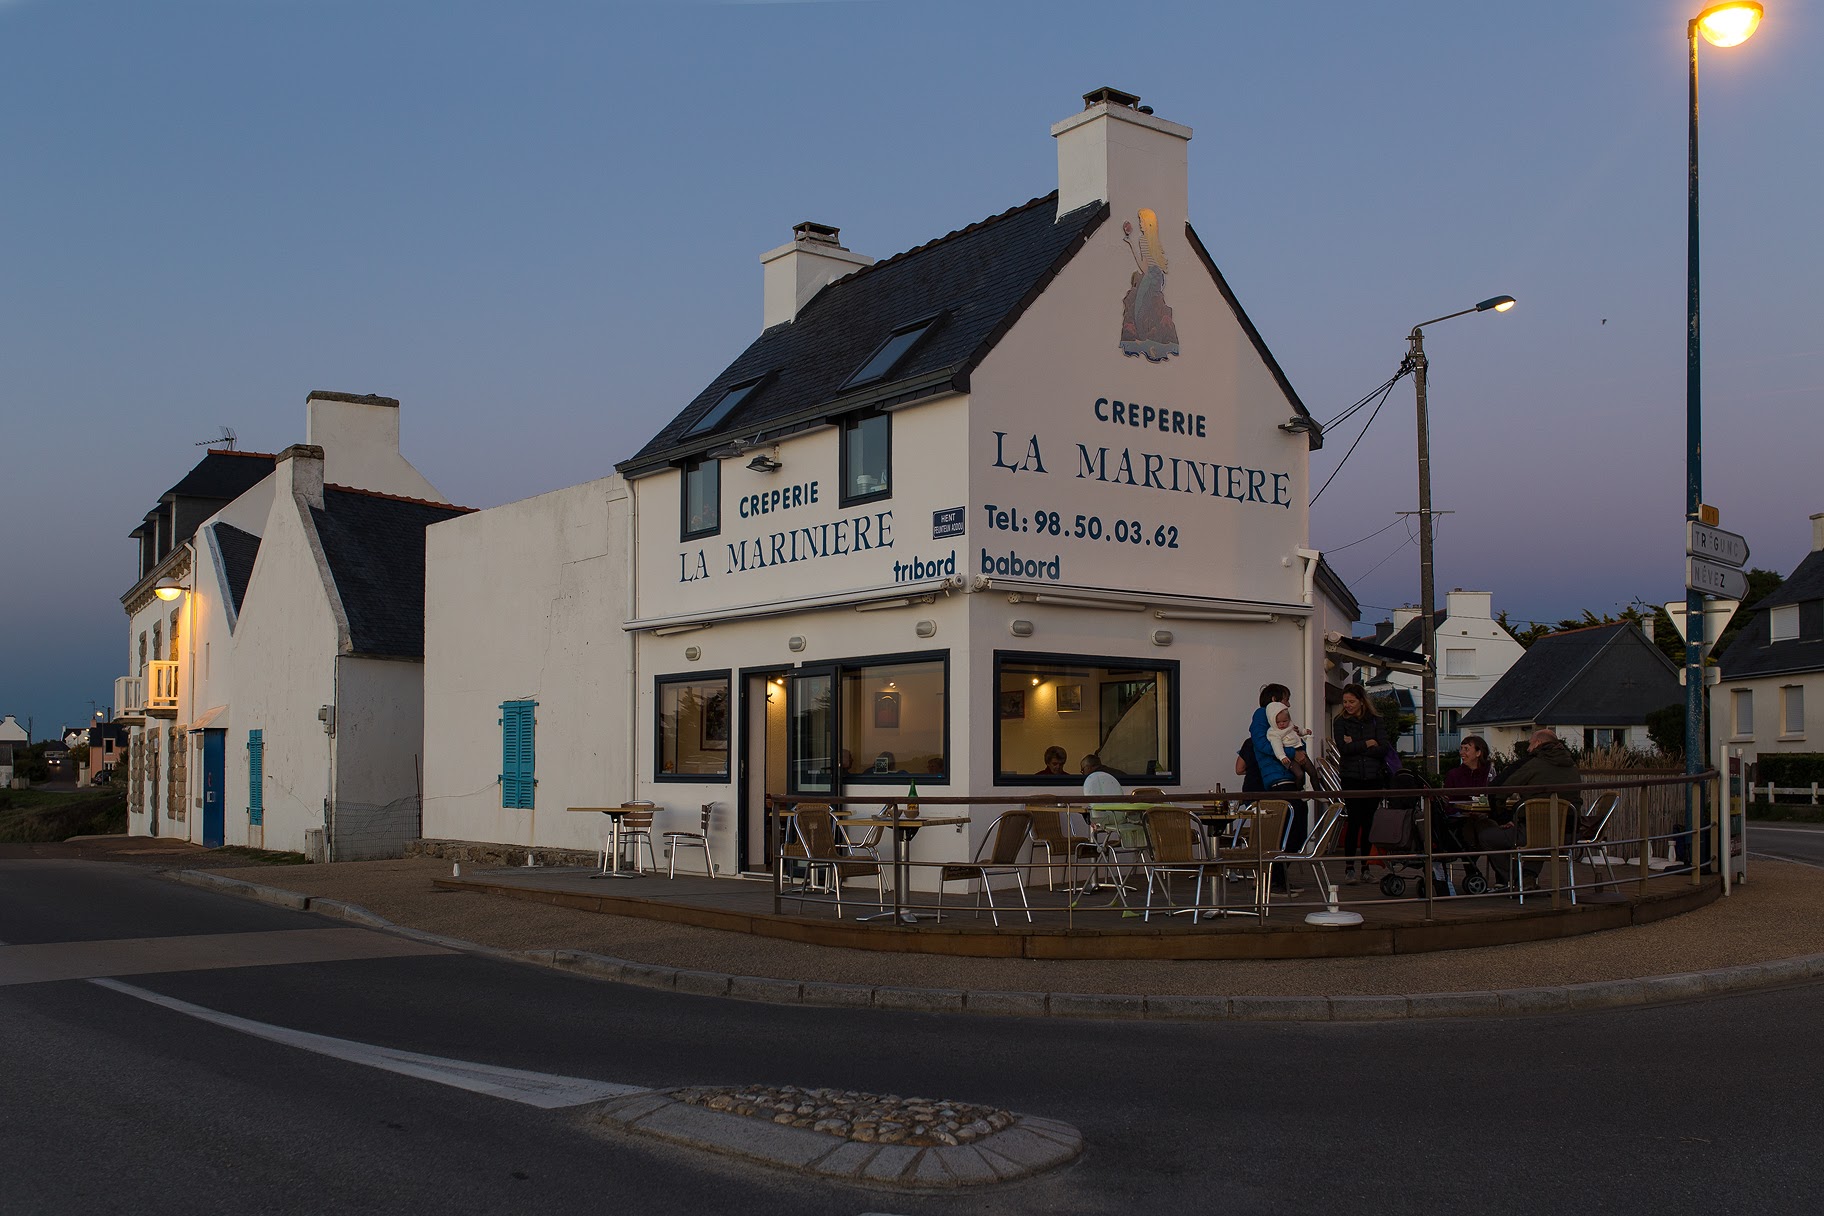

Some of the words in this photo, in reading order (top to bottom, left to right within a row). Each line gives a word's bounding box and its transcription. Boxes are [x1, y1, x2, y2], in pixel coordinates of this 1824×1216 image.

[1094, 397, 1207, 438] CREPERIE
[991, 430, 1049, 474] LA
[1075, 443, 1293, 510] MARINIERE
[739, 480, 820, 519] CREPERIE
[940, 512, 956, 523] HENT
[984, 504, 1028, 533] Tel:
[1034, 509, 1179, 549] 98.50.03.62
[1695, 530, 1739, 558] TRÉGUNC
[679, 549, 710, 583] LA
[726, 510, 895, 574] MARINIERE
[981, 547, 1061, 580] babord
[893, 549, 956, 582] tribord
[1694, 565, 1725, 589] NÉVEZ
